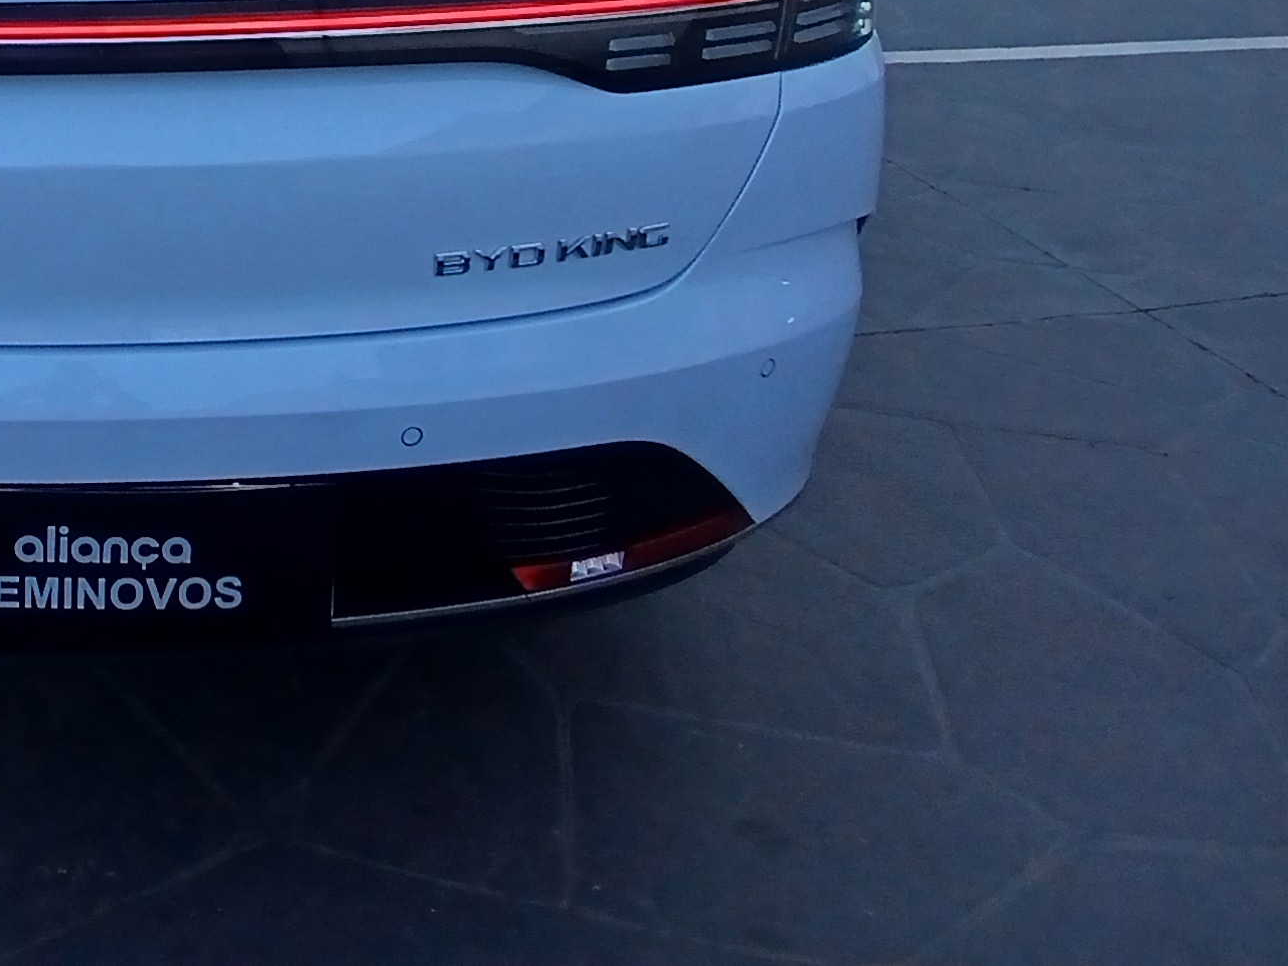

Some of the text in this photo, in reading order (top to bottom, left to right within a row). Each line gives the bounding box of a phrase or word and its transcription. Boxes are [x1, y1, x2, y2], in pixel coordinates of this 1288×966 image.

[433, 222, 670, 277] BYD KING
[14, 525, 192, 570] aliança
